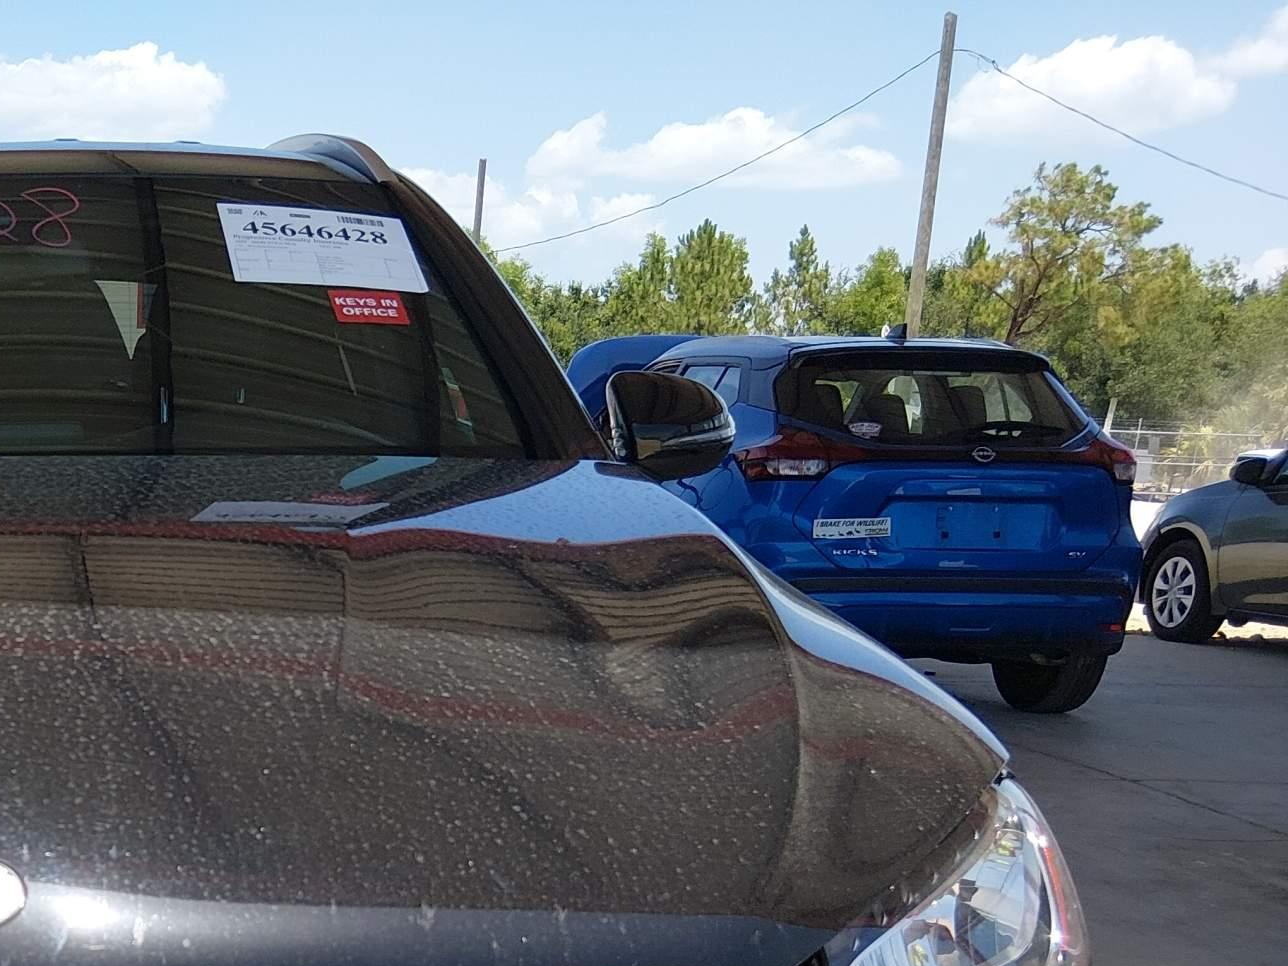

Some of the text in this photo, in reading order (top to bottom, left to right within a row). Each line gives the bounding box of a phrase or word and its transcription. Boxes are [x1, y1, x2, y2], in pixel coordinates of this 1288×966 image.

[242, 220, 388, 246] 45646428
[334, 297, 399, 308] KEYS IN
[342, 307, 399, 318] OFFICE
[820, 520, 842, 528] BRAKE
[832, 548, 878, 556] KICKS
